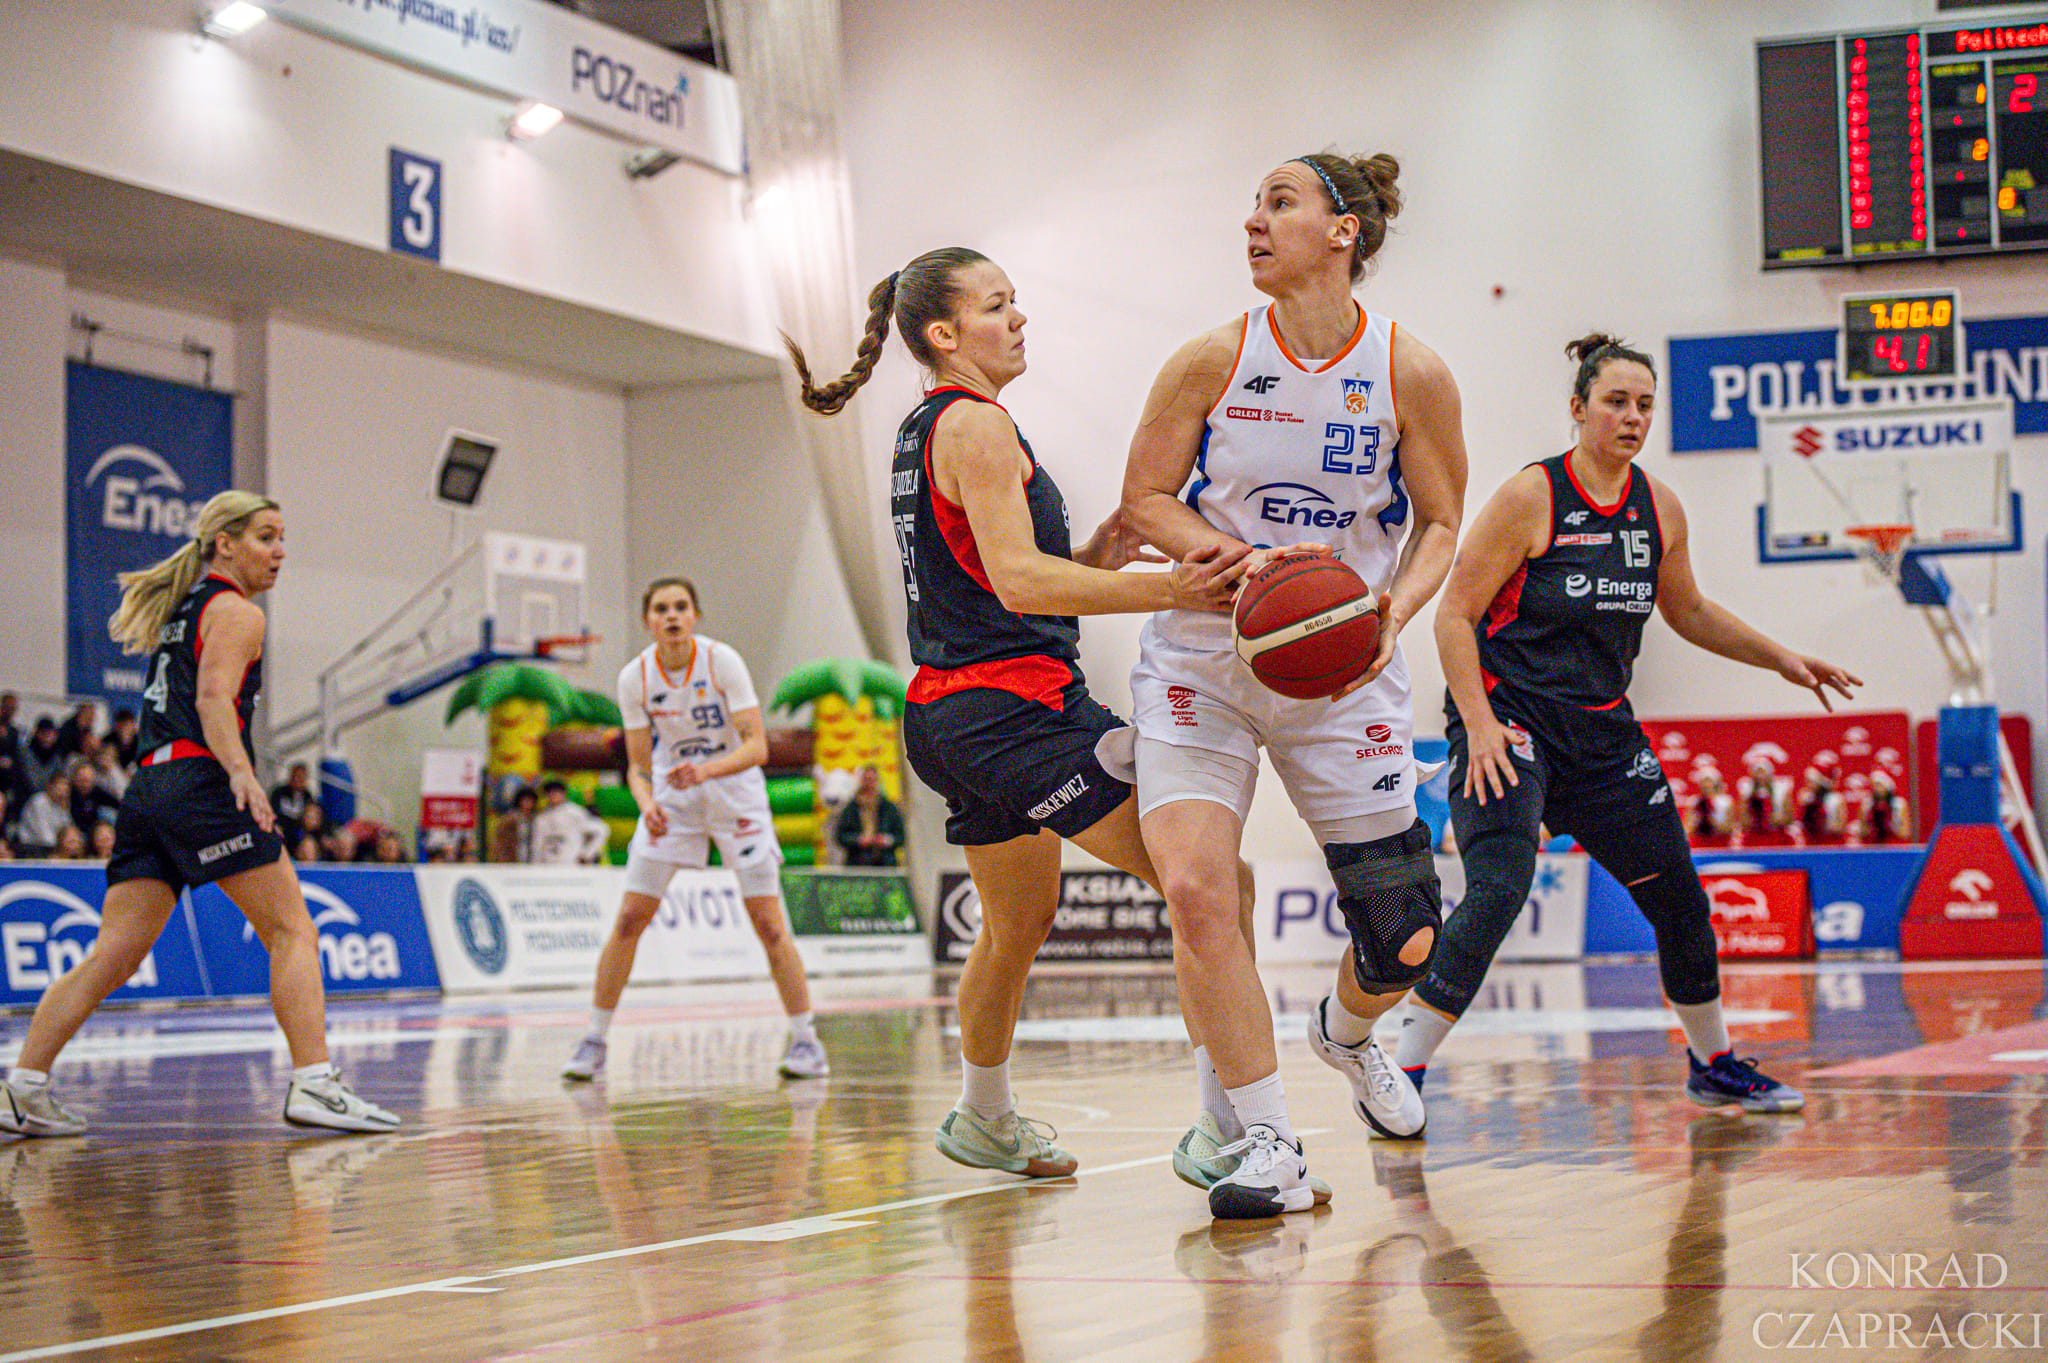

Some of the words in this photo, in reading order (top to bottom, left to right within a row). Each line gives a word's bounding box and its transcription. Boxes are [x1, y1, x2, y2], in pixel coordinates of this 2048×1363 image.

[2008, 73, 2037, 113] 2
[402, 161, 434, 249] 3
[1243, 375, 1281, 395] 4F
[1228, 408, 1259, 419] ORLEN
[1321, 422, 1380, 475] 23
[1834, 421, 1984, 452] SUZUKI
[1260, 496, 1358, 530] Enea
[1563, 510, 1591, 526] 4F
[1619, 529, 1651, 568] 15
[1259, 553, 1322, 583] molten
[1596, 577, 1653, 601] Energa
[1595, 601, 1626, 611] GRUPA
[691, 704, 724, 729] 93
[1355, 744, 1404, 760] SELGROS
[1371, 772, 1401, 791] 4F
[1, 921, 159, 990] En
